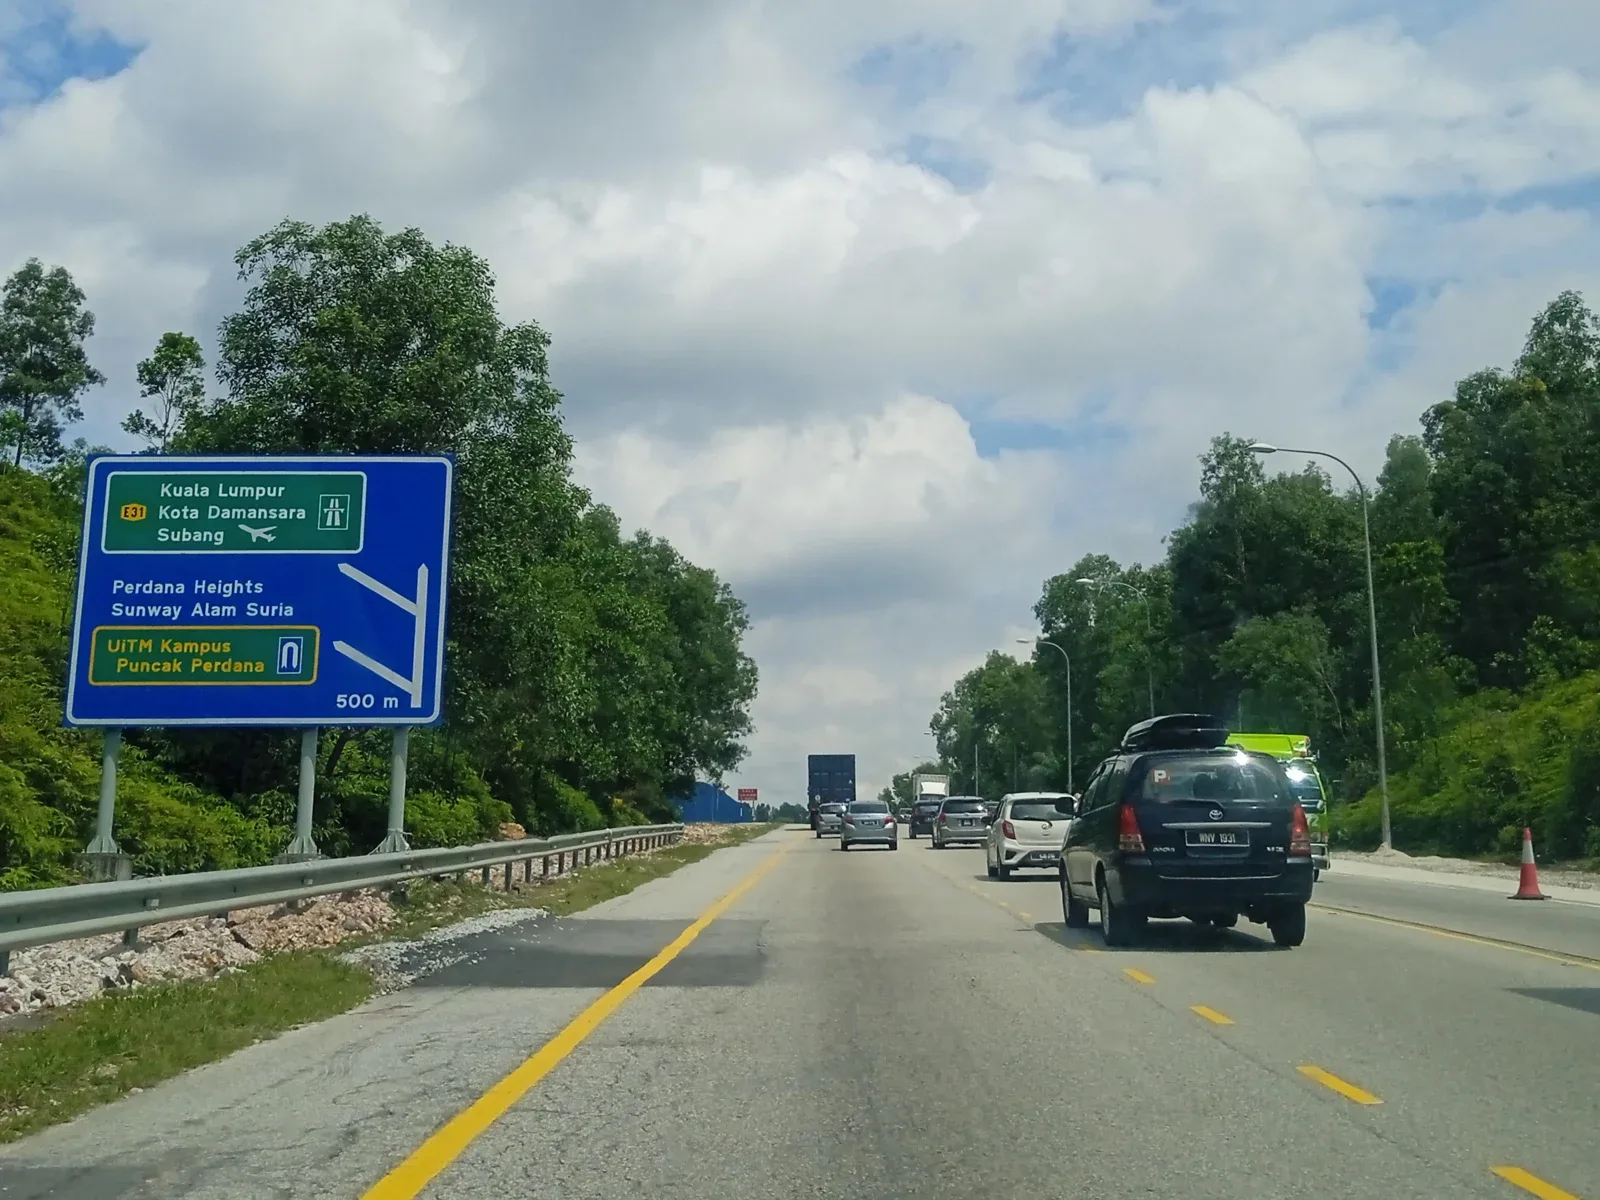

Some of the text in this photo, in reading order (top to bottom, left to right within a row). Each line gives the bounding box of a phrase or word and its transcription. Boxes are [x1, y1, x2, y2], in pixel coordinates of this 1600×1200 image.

[160, 483, 286, 500] Kuala Lumpur
[123, 506, 144, 518] E31
[158, 505, 306, 520] Kota Damansara
[157, 528, 225, 545] Subang
[112, 580, 264, 598] Perdana Heights
[111, 602, 294, 620] Sunway Alam Suria
[107, 639, 231, 656] UiTM Kampus
[116, 658, 265, 673] Puncak Perdana
[336, 693, 399, 709] 500 m
[1154, 769, 1167, 783] P
[1219, 833, 1236, 844] 1931
